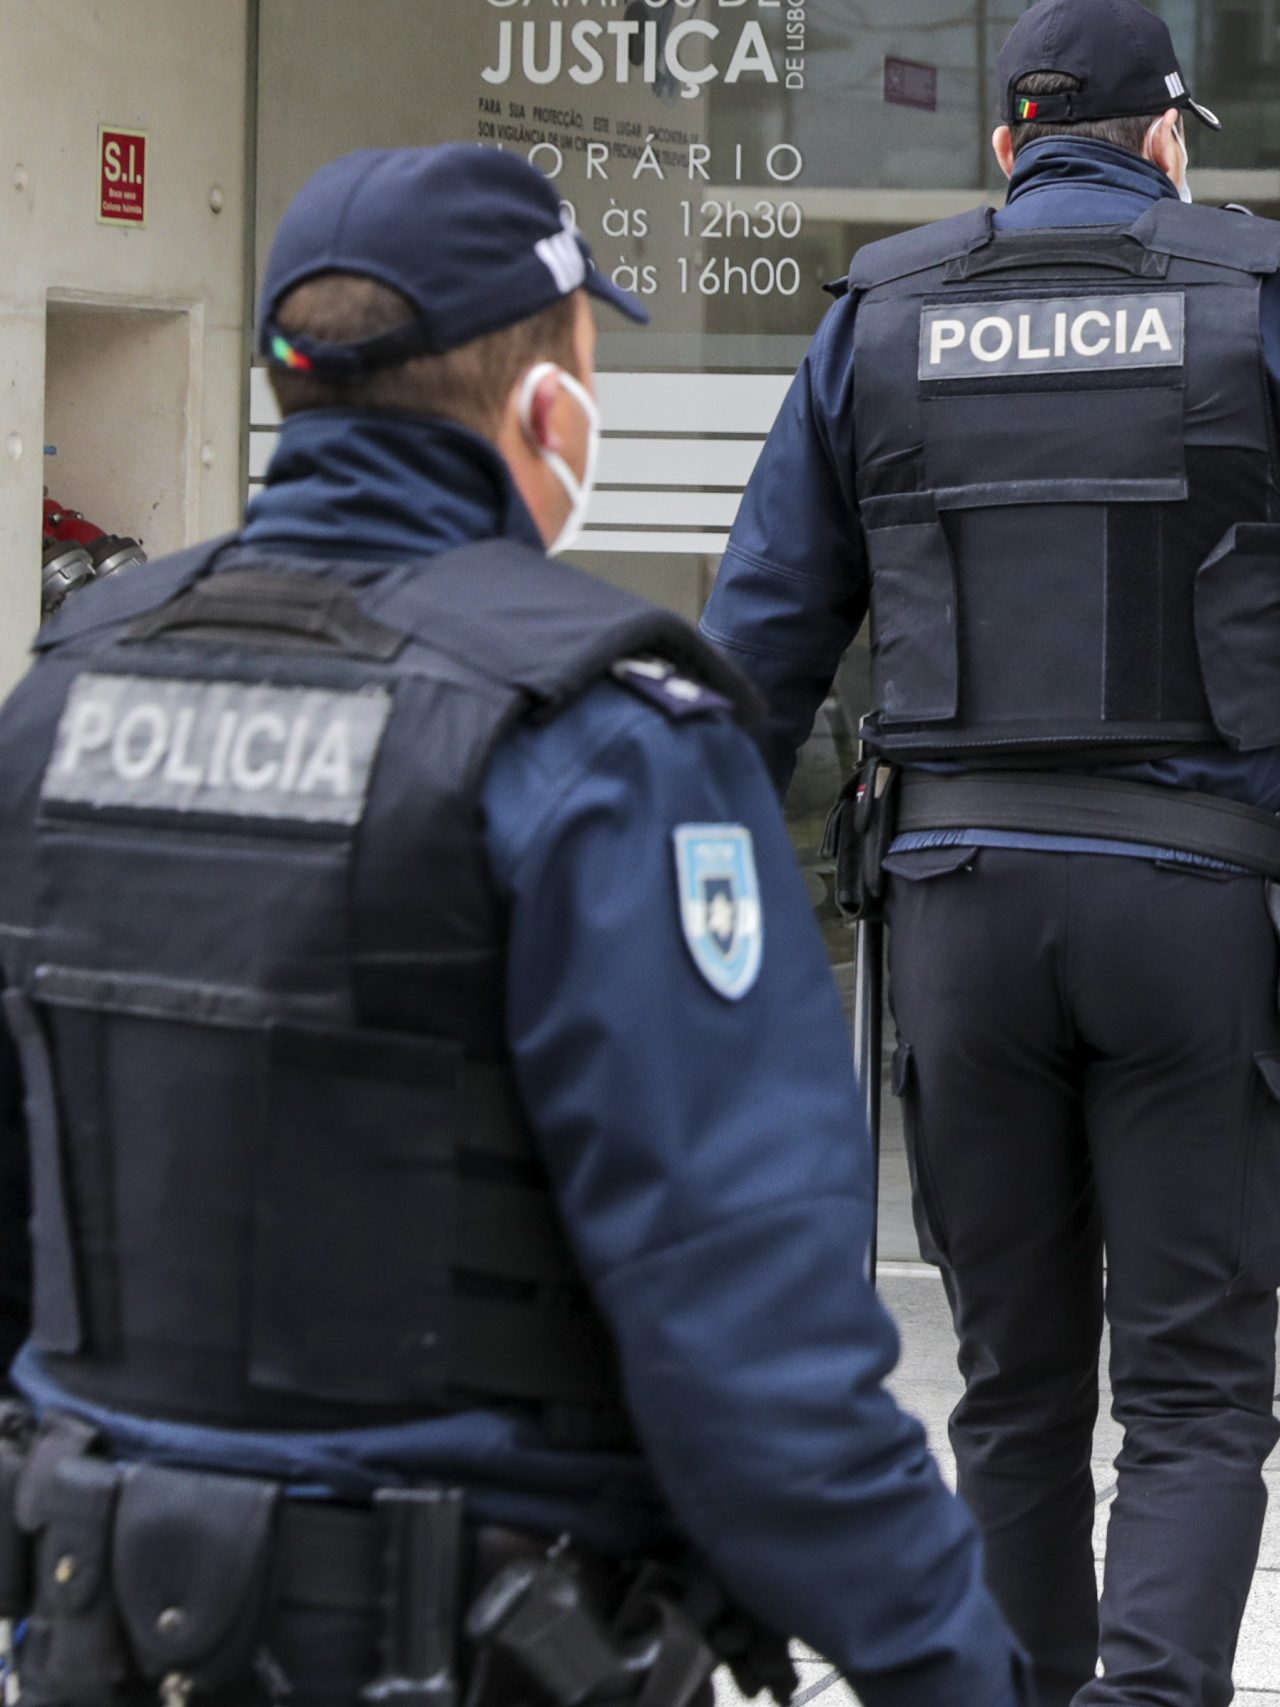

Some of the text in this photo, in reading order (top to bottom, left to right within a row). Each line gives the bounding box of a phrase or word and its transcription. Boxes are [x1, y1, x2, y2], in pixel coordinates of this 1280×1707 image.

[480, 19, 779, 98] JUSTIÇA
[785, 58, 804, 89] DE
[104, 141, 142, 184] S.I.
[478, 133, 802, 181] ORÁRIO
[602, 198, 648, 237] às
[680, 201, 801, 238] 12h30
[611, 256, 800, 295] às 16h00
[929, 307, 1172, 364] POLICIA
[60, 701, 353, 796] POLICIA
